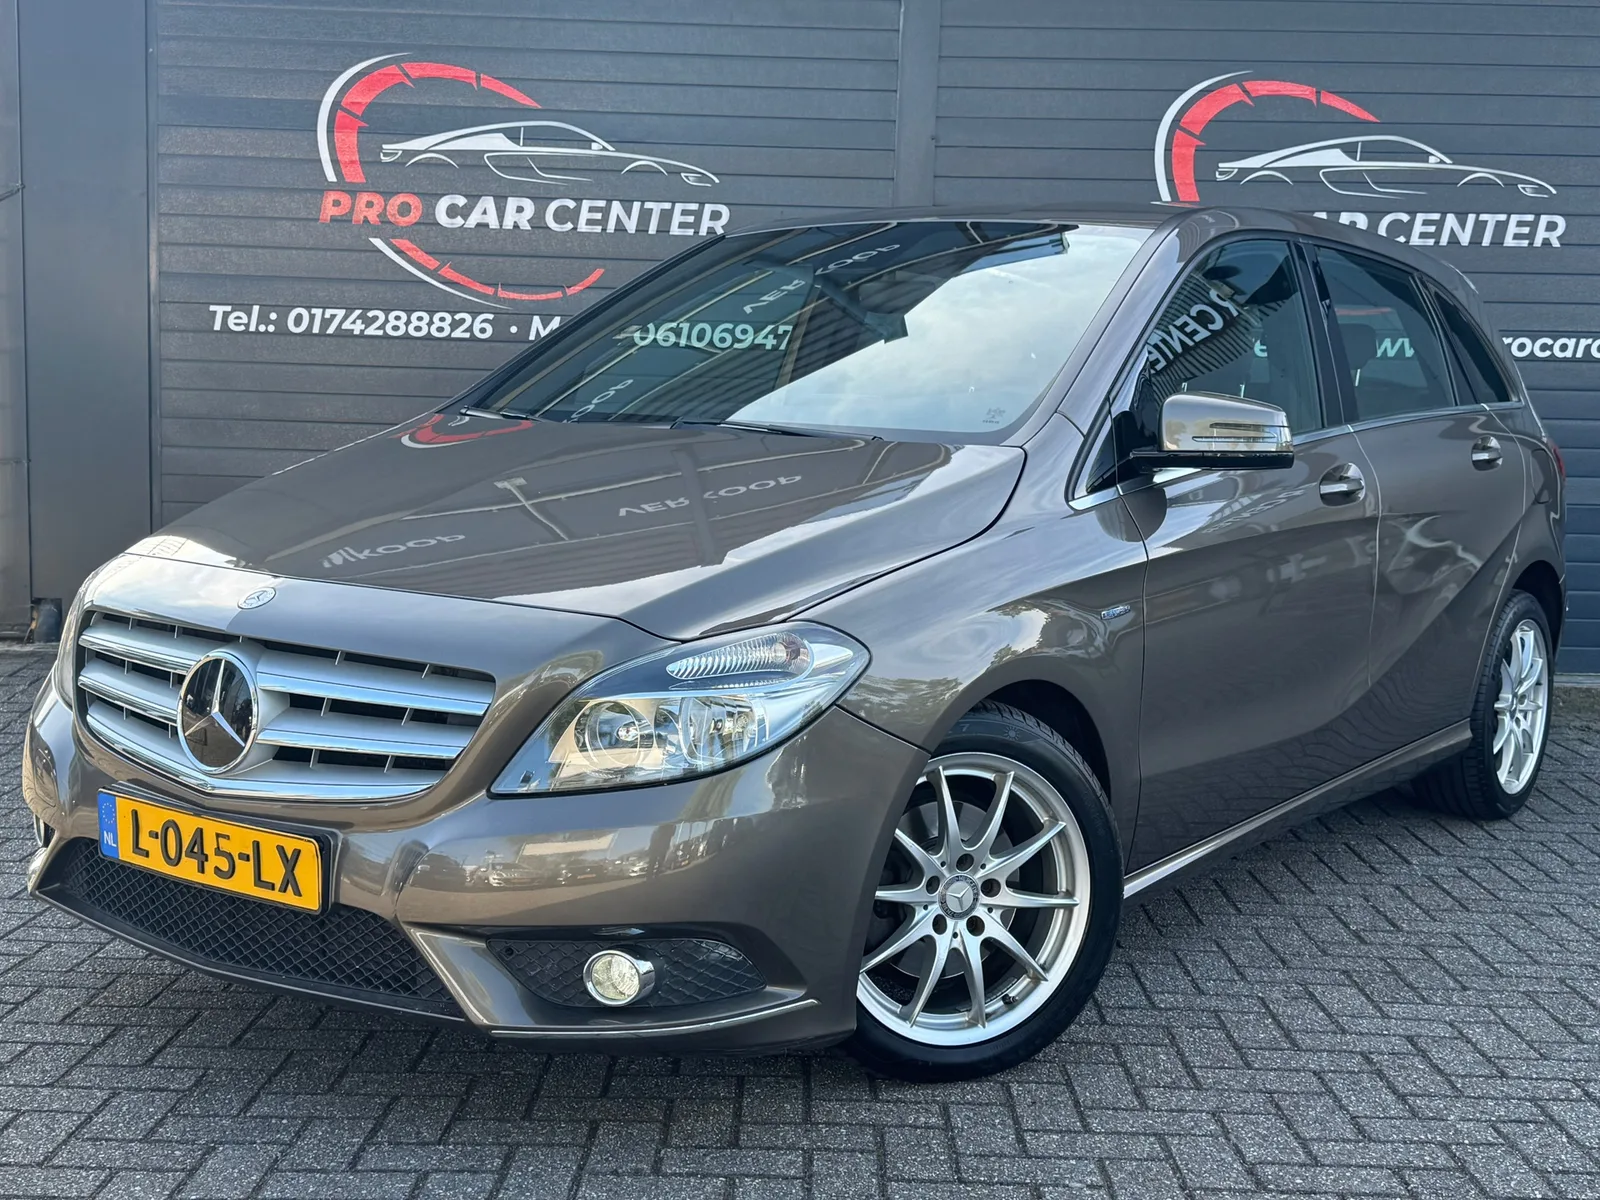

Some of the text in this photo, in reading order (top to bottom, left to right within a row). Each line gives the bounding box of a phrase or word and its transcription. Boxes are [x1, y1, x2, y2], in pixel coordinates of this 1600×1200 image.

[319, 190, 731, 236] PRO CAR CENTER
[1377, 211, 1567, 248] CENTER
[209, 304, 278, 333] Tel.:
[287, 306, 495, 340] 0174288826
[103, 830, 117, 848] NL
[130, 808, 302, 897] L-045-LX
